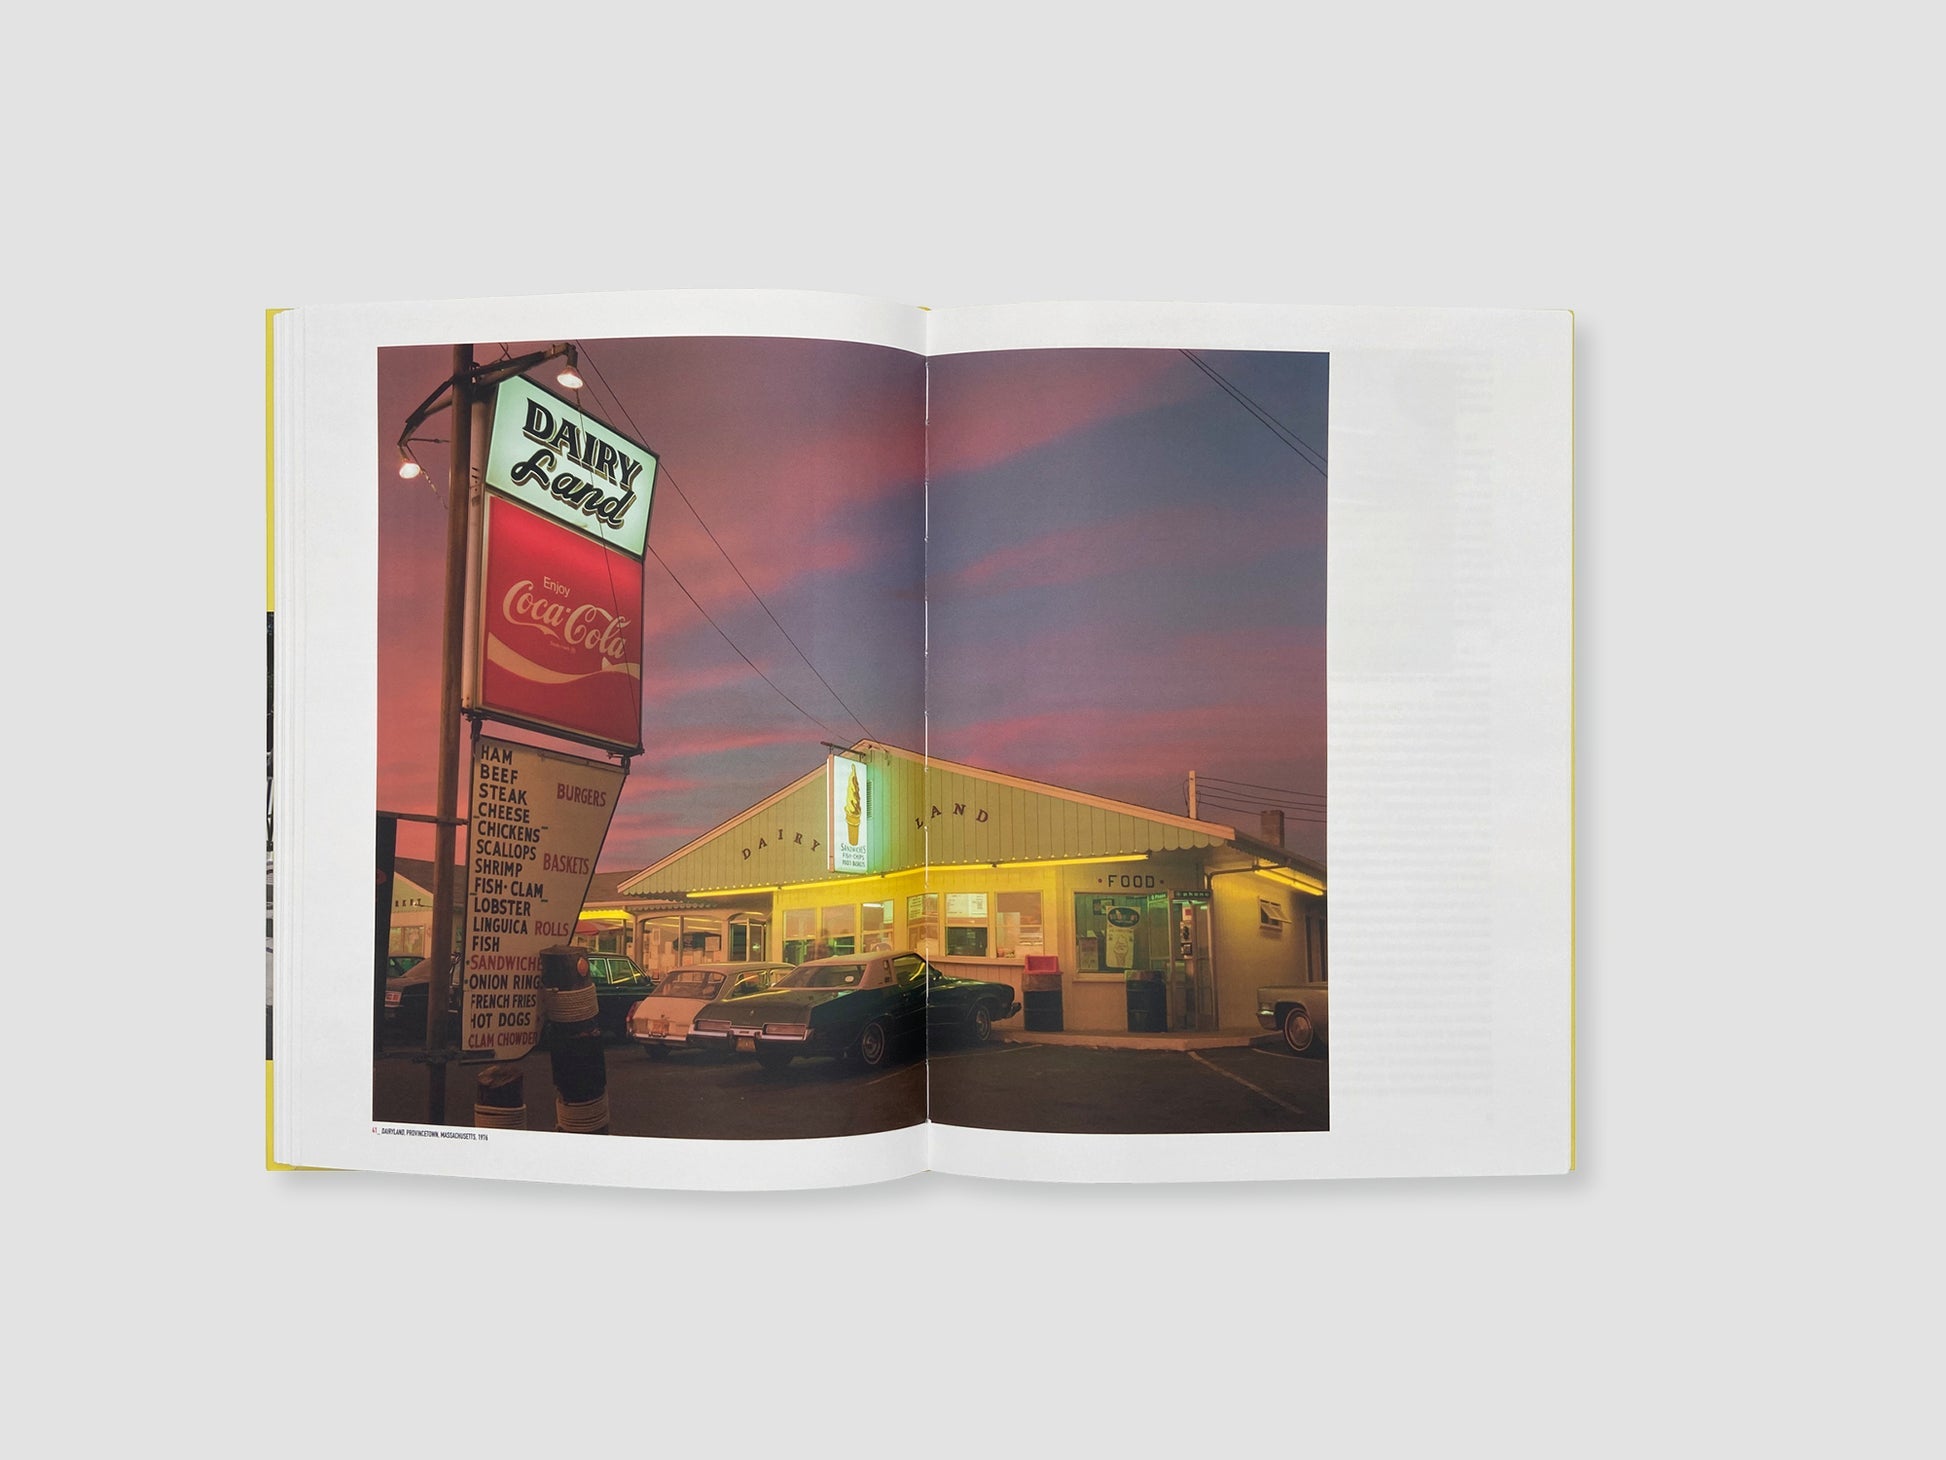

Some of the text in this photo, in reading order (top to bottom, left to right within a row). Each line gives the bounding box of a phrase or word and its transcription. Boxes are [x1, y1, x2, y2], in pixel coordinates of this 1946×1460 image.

[522, 398, 643, 490] DAIRY
[511, 448, 636, 529] Land
[543, 576, 570, 598] Enjoy
[503, 580, 631, 659] Coca-Cola
[481, 745, 513, 765] HAM
[480, 763, 518, 785] BEEF
[479, 783, 527, 805] STEAK
[557, 783, 607, 807] BURGERS
[478, 802, 530, 824] CHEESE
[477, 820, 540, 843] CHICKENS
[742, 803, 989, 860] DAIRY LAND
[476, 839, 536, 861] SCALLOPS
[475, 858, 523, 878] SHRIMP
[543, 852, 589, 875] BASKETS
[511, 881, 544, 898] CLAM
[1108, 874, 1155, 888] FOOD
[474, 897, 531, 916] LOBSTER
[473, 917, 569, 937] LINGUICA ROLLS
[472, 936, 500, 952] FISH
[470, 954, 544, 971] SANDWICHE
[469, 974, 543, 990] ONION RING
[471, 994, 537, 1009] FRENCH FRIES
[498, 1012, 531, 1027] DOGS
[468, 1032, 538, 1048] CLAM CHOWDER
